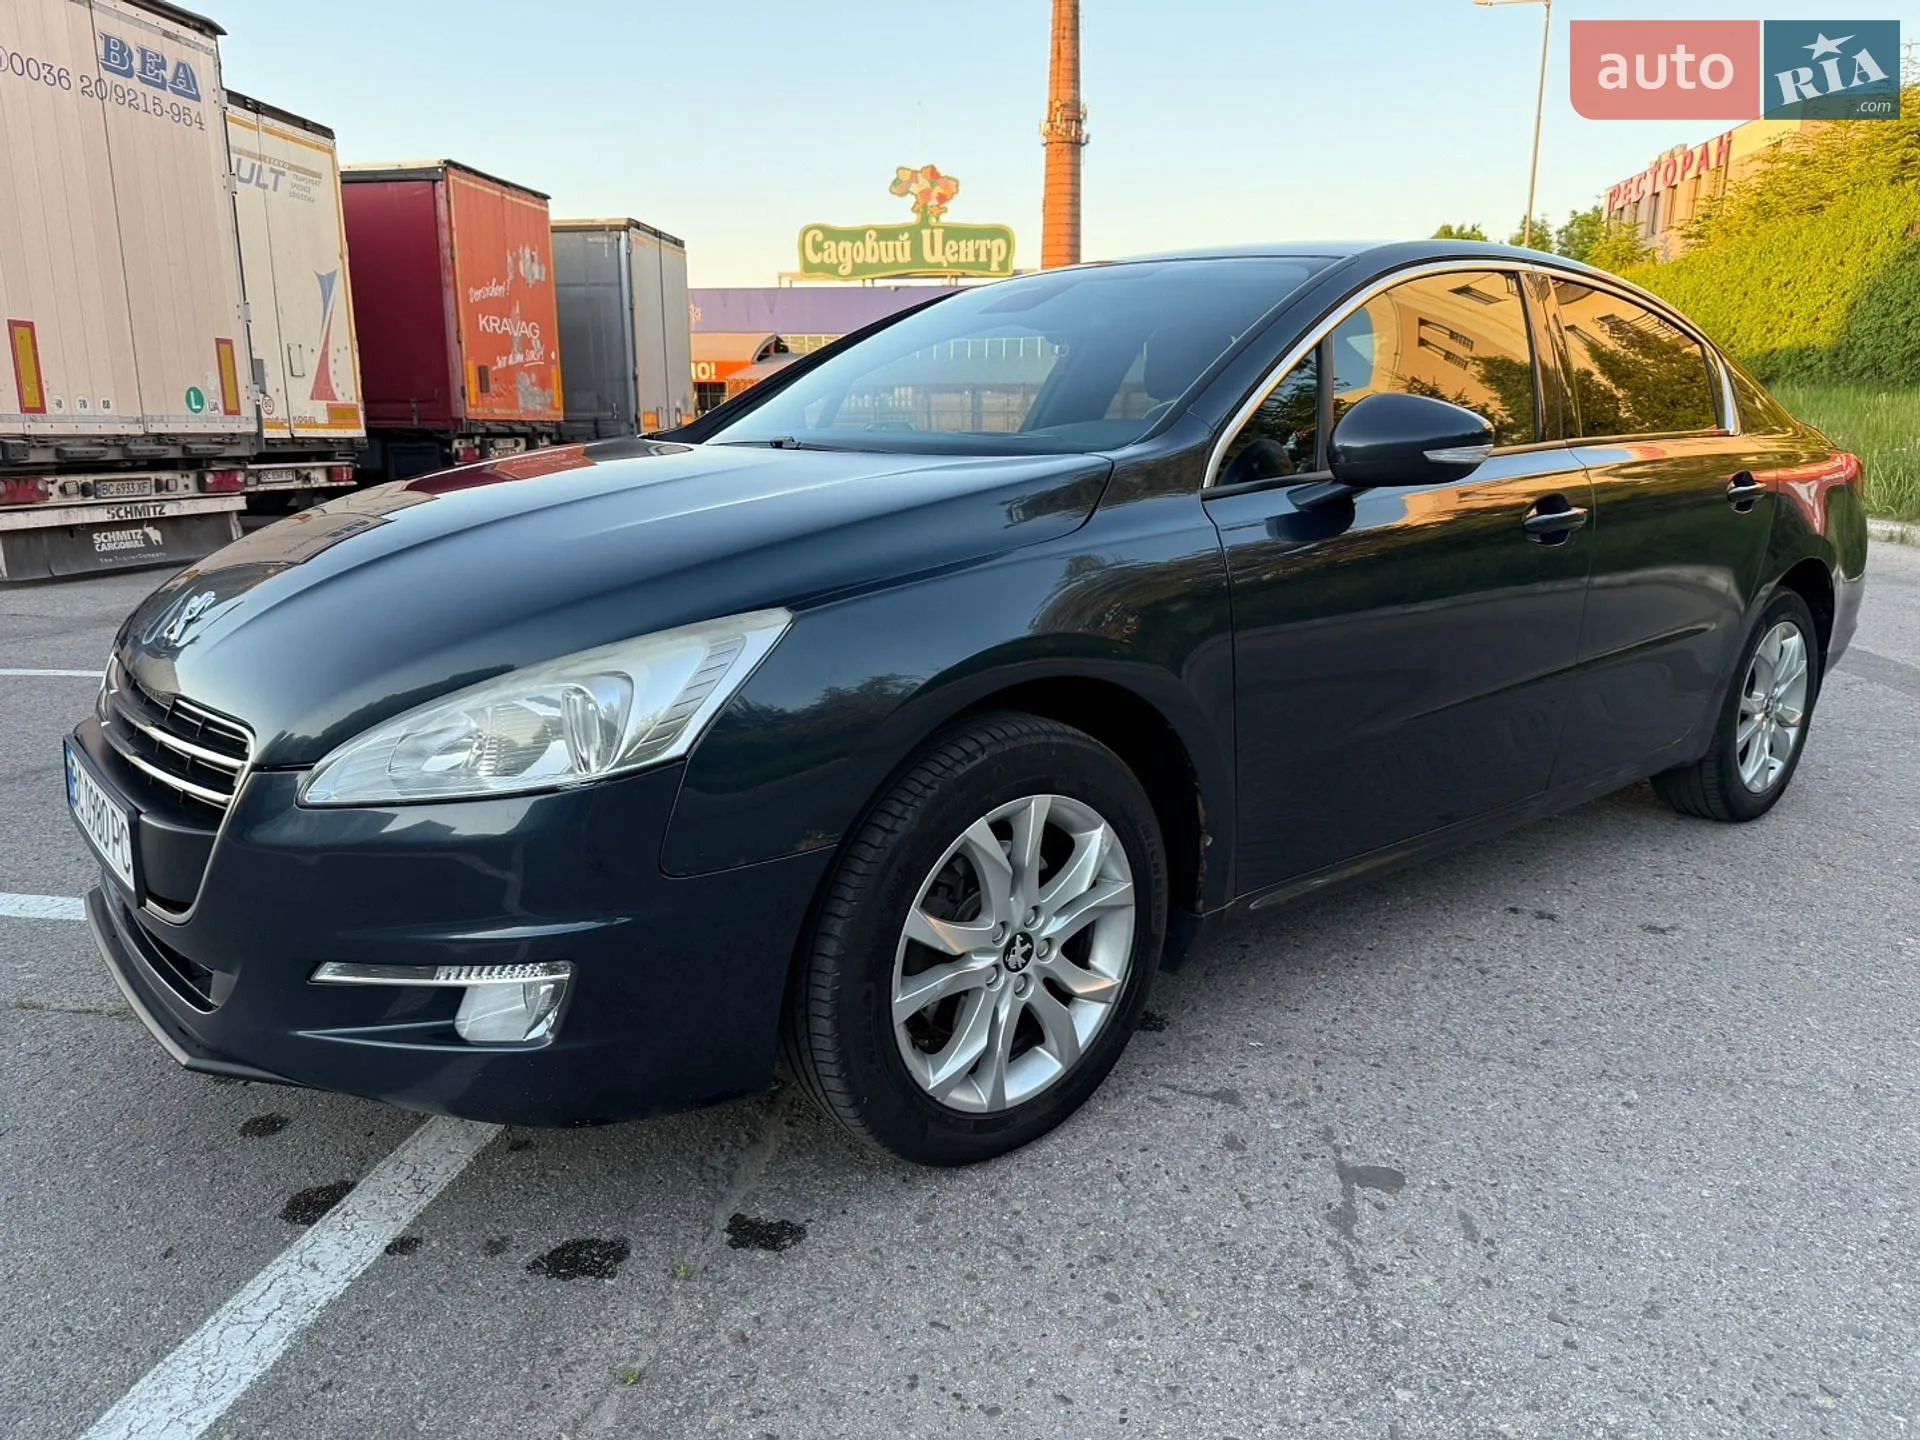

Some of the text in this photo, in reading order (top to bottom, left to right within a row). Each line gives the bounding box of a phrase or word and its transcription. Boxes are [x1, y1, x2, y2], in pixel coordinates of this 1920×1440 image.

[98, 31, 202, 103] BEA
[79, 74, 206, 131] 20/9215-954
[1608, 130, 1733, 212] РЕСТОРАН
[804, 228, 1007, 277] Садовий Центр
[478, 313, 541, 339] KRAVAG
[102, 484, 114, 496] BC
[116, 482, 135, 494] 6933
[106, 504, 166, 520] SCHMITZ
[92, 529, 145, 544] SCHMITZ
